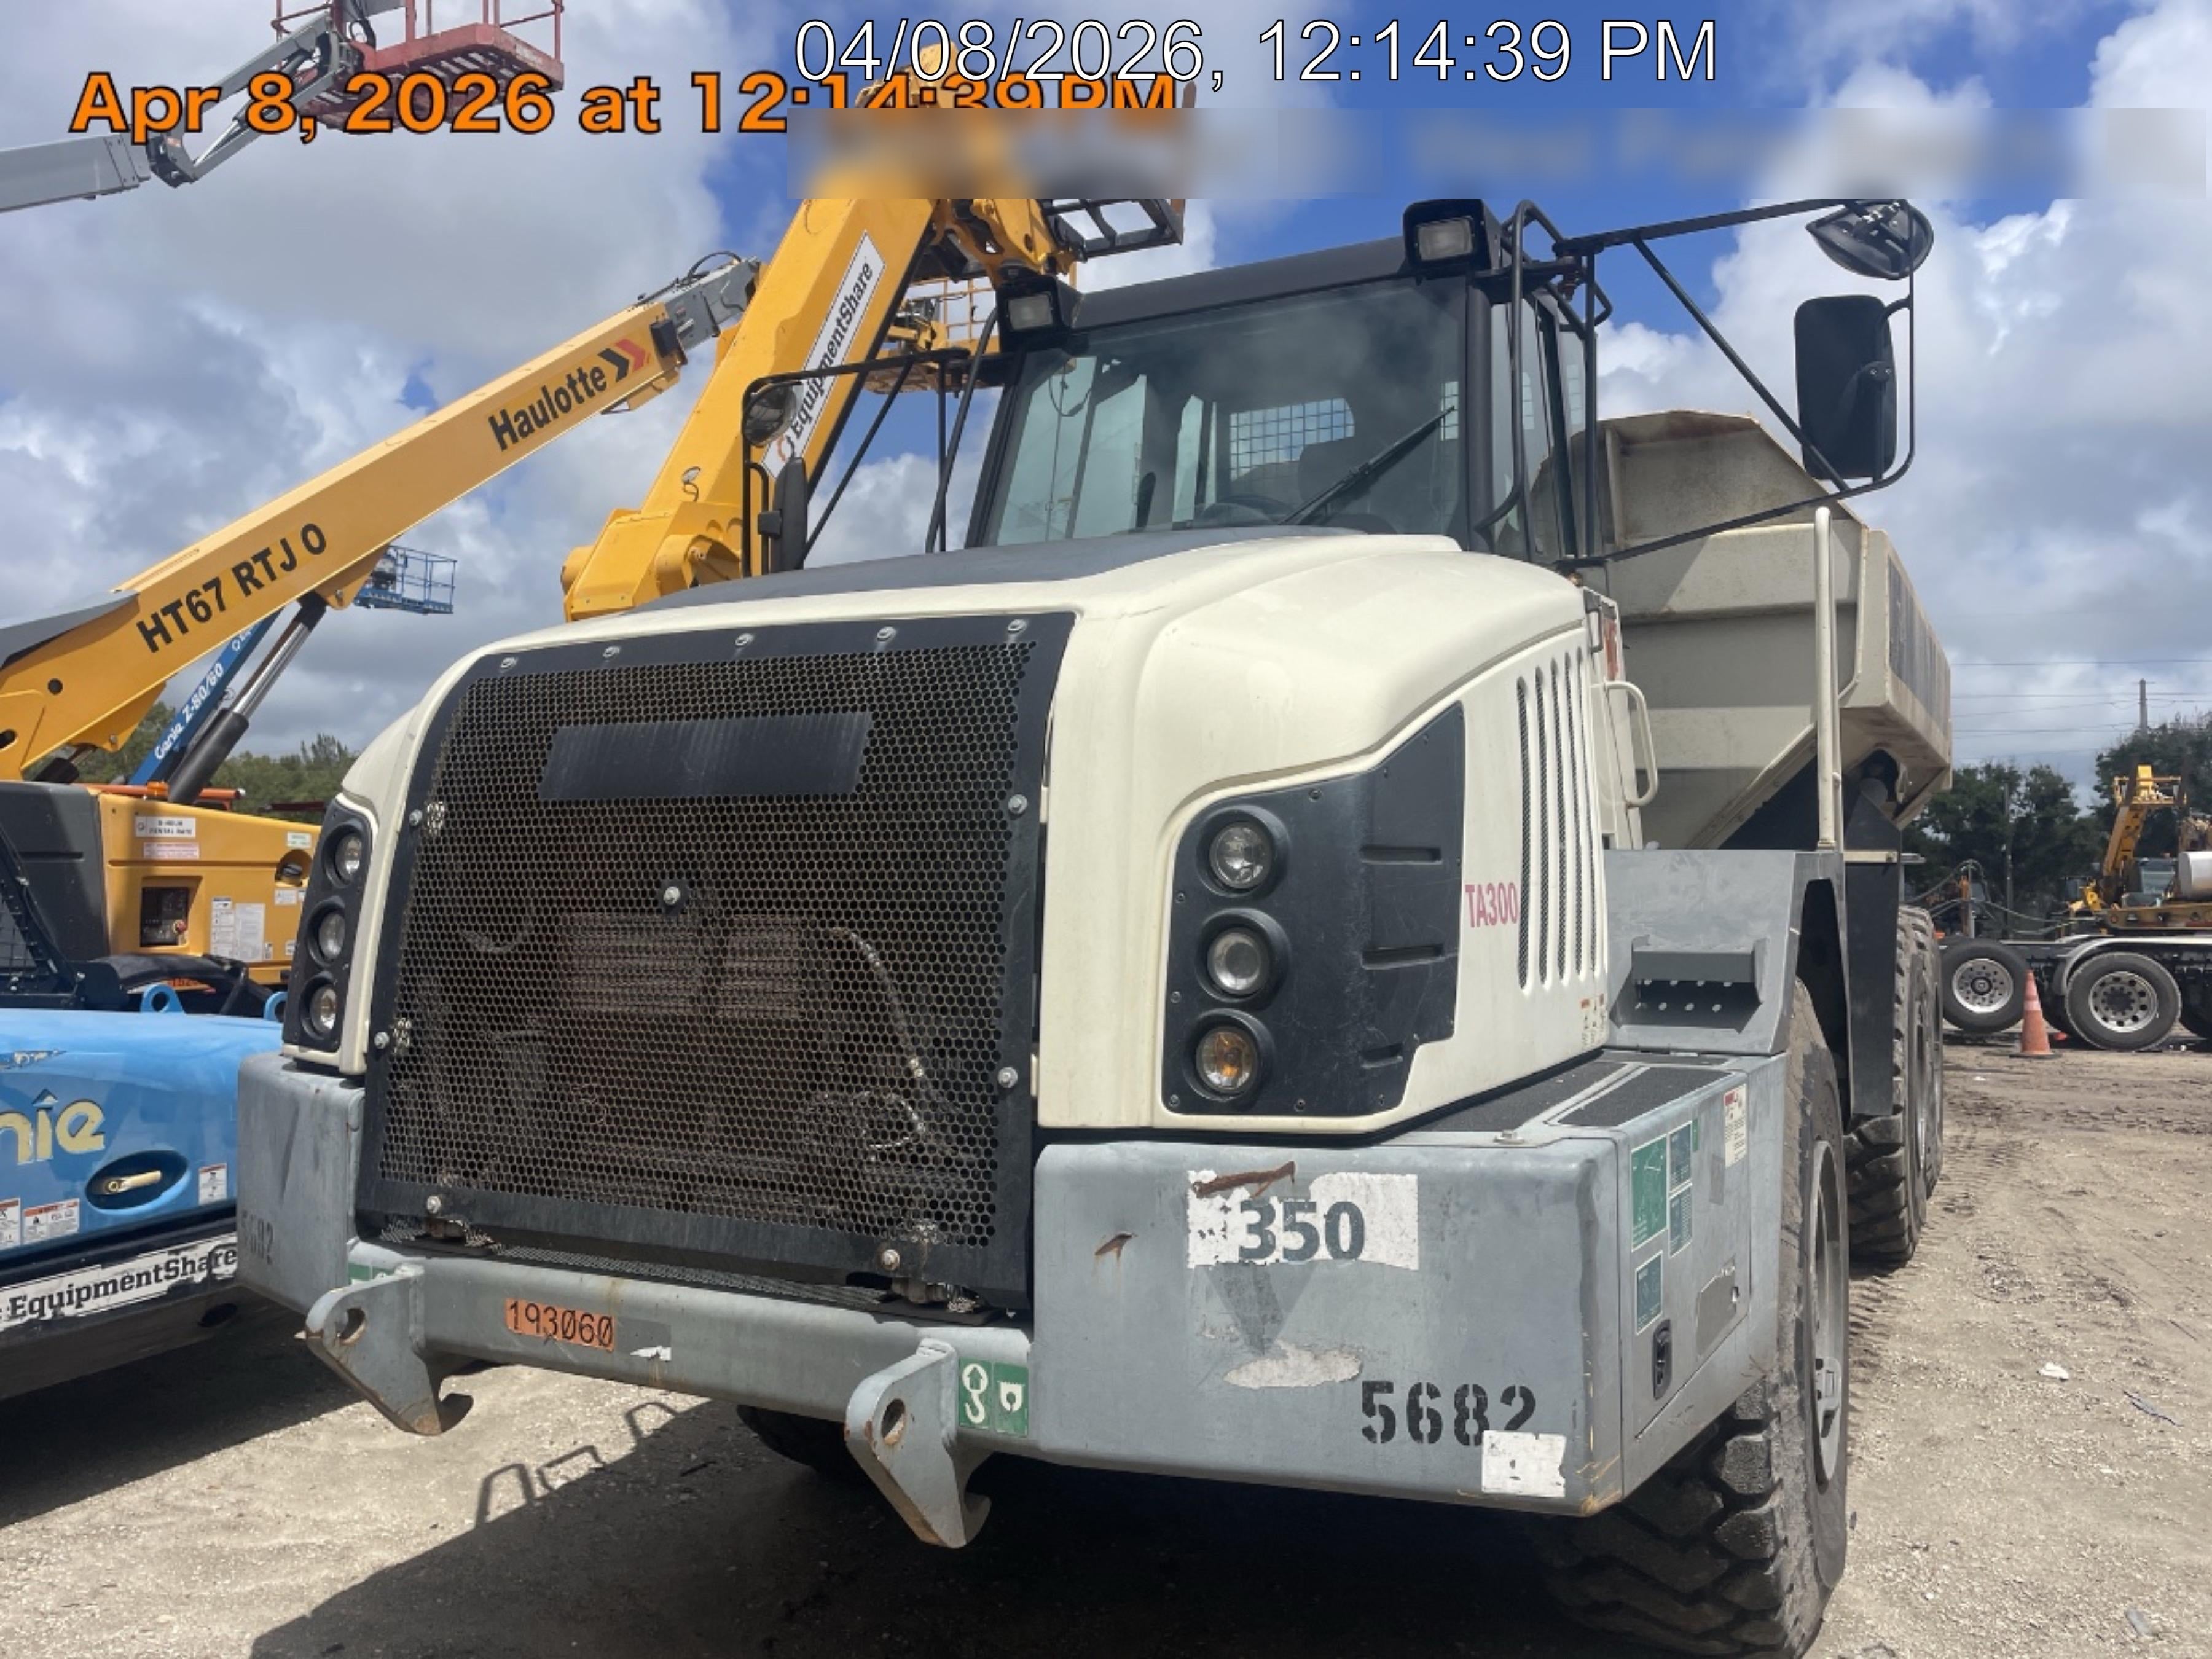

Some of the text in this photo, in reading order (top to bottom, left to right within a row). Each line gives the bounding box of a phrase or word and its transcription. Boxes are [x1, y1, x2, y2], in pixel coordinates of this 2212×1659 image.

[488, 361, 608, 452] Haulotte
[136, 576, 230, 653] HT67
[232, 538, 298, 597] RTJ
[154, 662, 224, 760] Genie Z-80/60
[1465, 882, 1518, 928] TA300
[1238, 1199, 1365, 1261] 350
[9, 1248, 237, 1320] EquipmentShare
[509, 1300, 613, 1347] 193060
[1360, 1380, 1536, 1446] 5682
